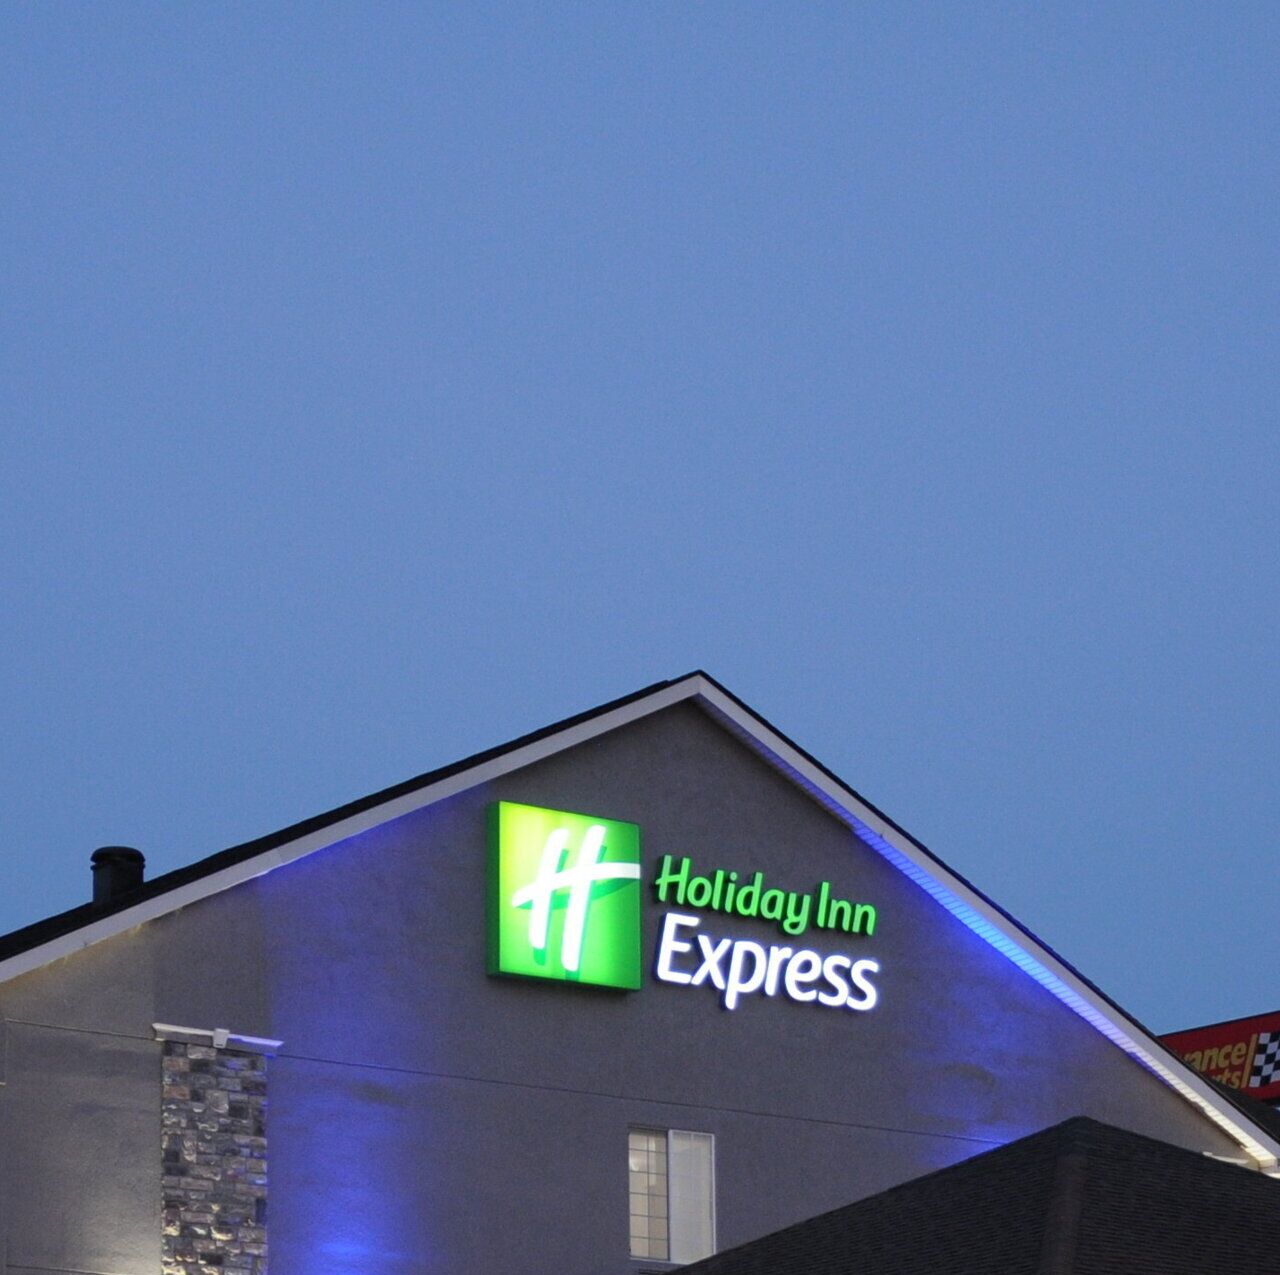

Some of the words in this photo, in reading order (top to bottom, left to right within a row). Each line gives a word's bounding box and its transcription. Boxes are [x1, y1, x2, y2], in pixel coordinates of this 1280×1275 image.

[655, 854, 811, 936] Holiday
[817, 881, 877, 937] Inn
[655, 912, 881, 1010] Express
